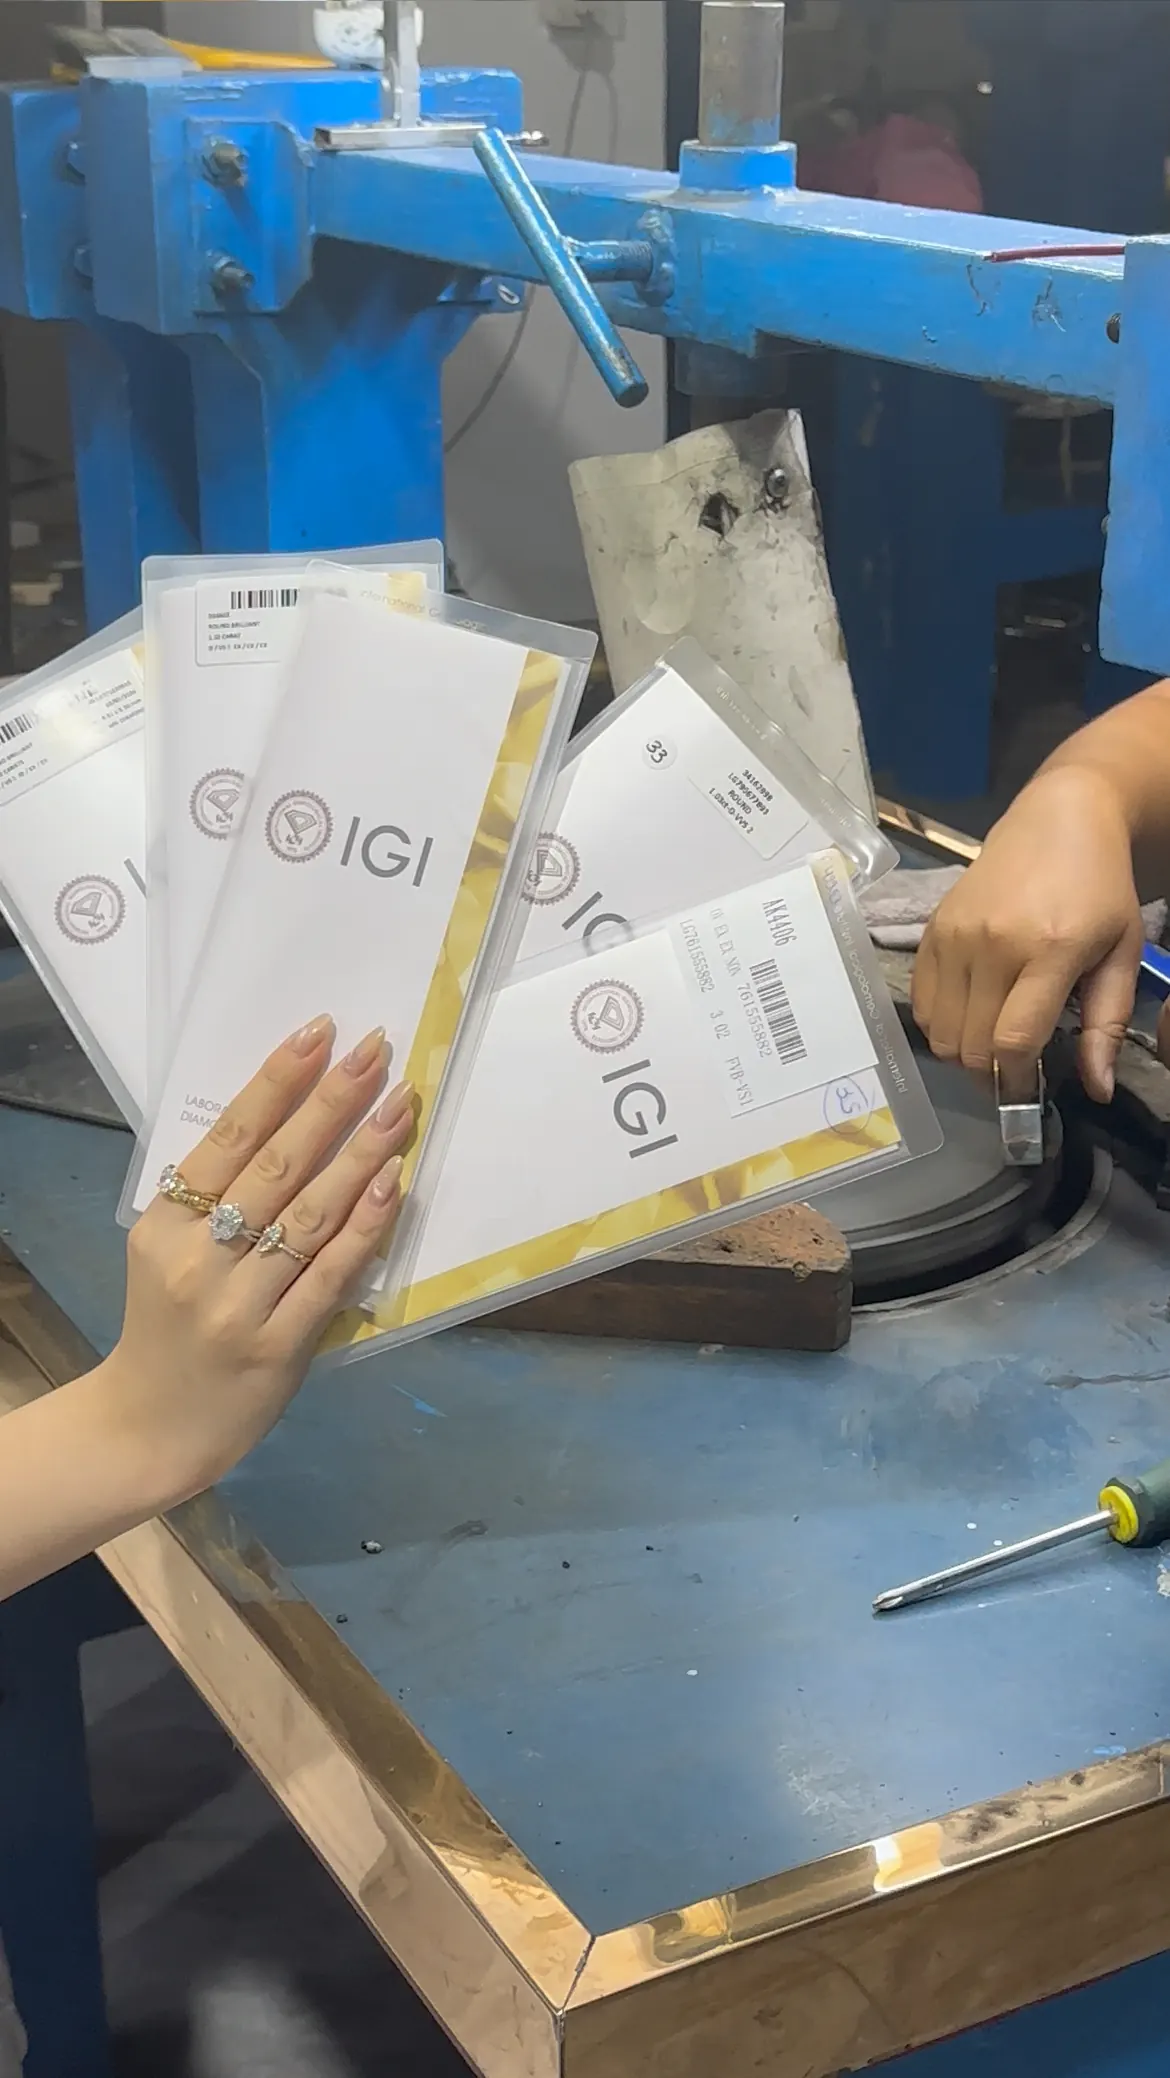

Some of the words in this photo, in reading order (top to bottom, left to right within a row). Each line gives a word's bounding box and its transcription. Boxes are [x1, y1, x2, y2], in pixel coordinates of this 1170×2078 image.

[645, 739, 669, 764] 33
[727, 789, 752, 815] ROUND
[340, 815, 434, 888] IGI
[562, 891, 637, 958] IG
[762, 898, 798, 947] AK4406
[736, 982, 773, 1058] 761555882
[601, 1058, 679, 1159] IGI
